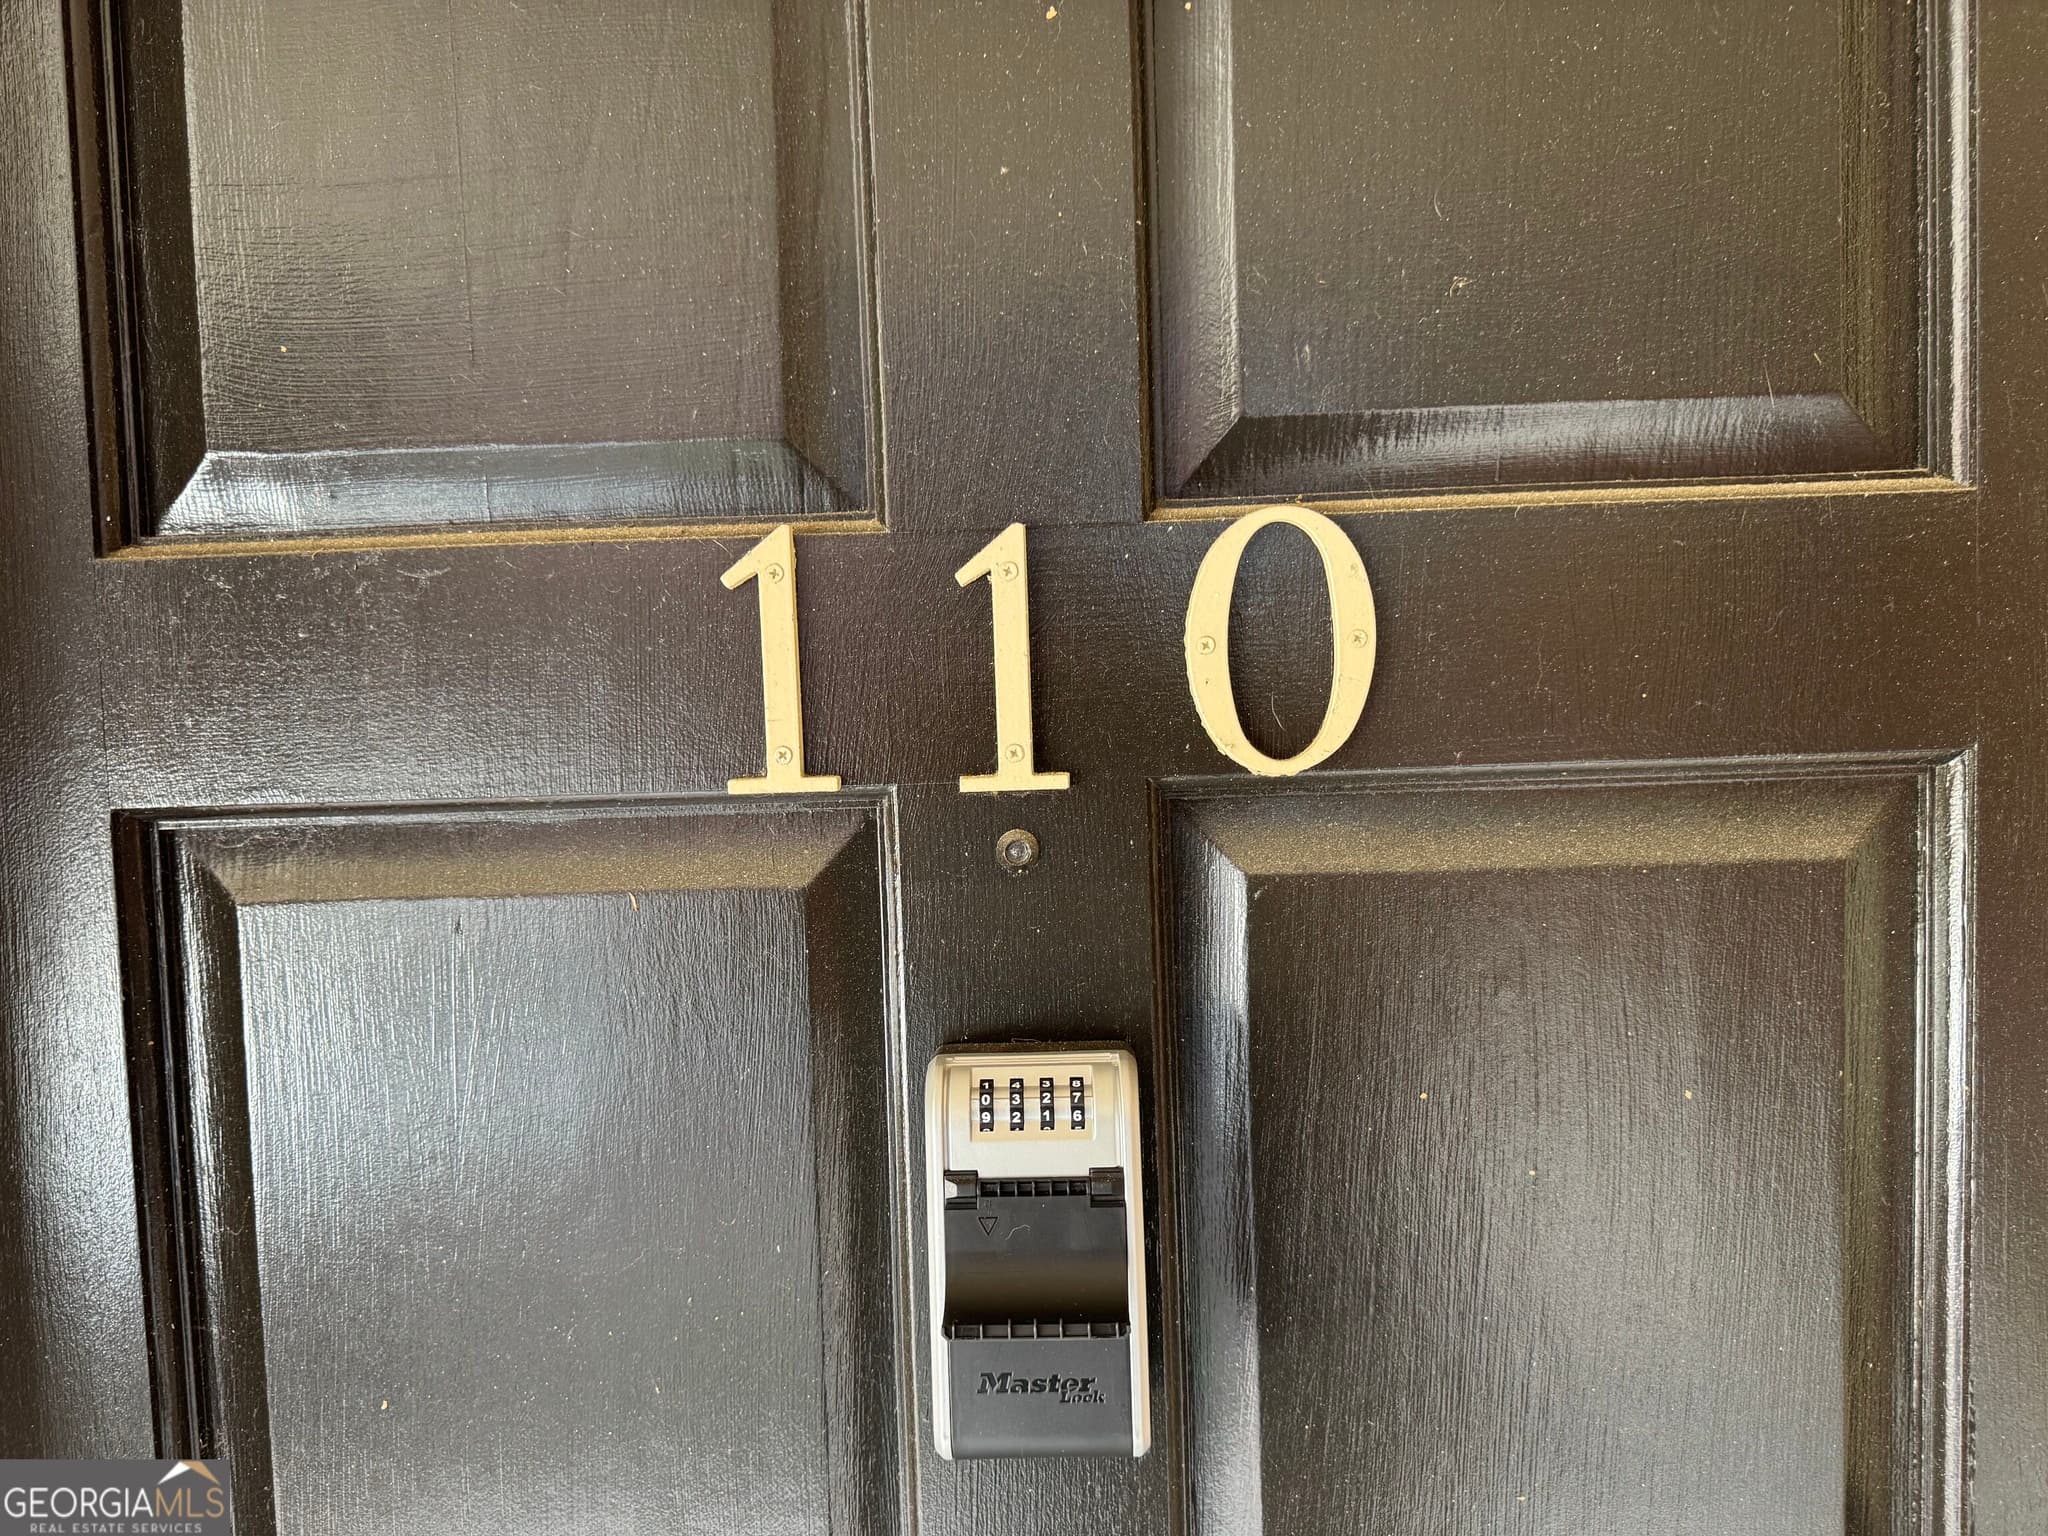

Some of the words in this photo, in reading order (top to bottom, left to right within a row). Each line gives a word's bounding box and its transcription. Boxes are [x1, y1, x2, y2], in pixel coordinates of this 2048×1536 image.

[720, 505, 1376, 793] 110
[977, 1371, 1097, 1394] Master
[1059, 1390, 1105, 1403] Lock
